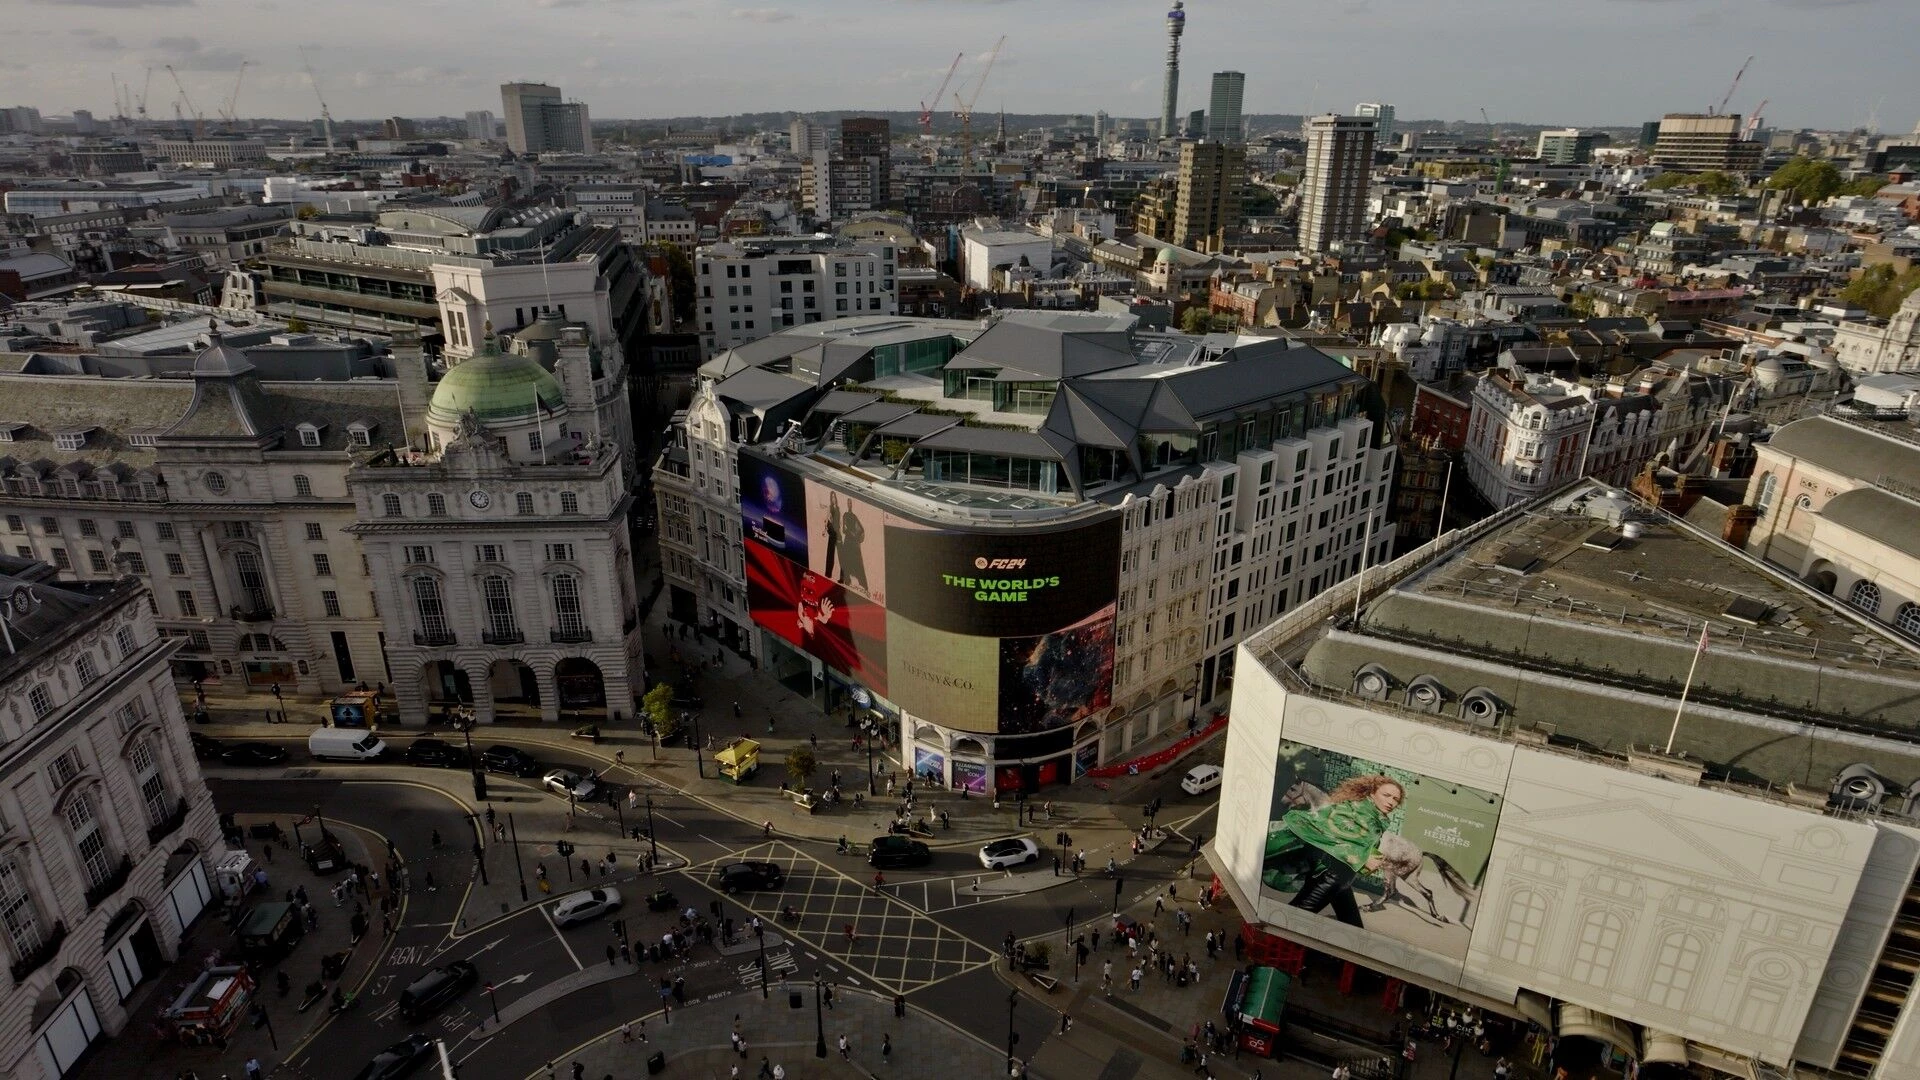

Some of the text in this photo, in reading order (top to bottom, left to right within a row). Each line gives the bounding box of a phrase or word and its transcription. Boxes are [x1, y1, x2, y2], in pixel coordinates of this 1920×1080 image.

[988, 559, 1027, 570] FC24
[942, 574, 1060, 591] THE WORLD'S
[974, 591, 1028, 602] GAME
[371, 974, 397, 996] ST
